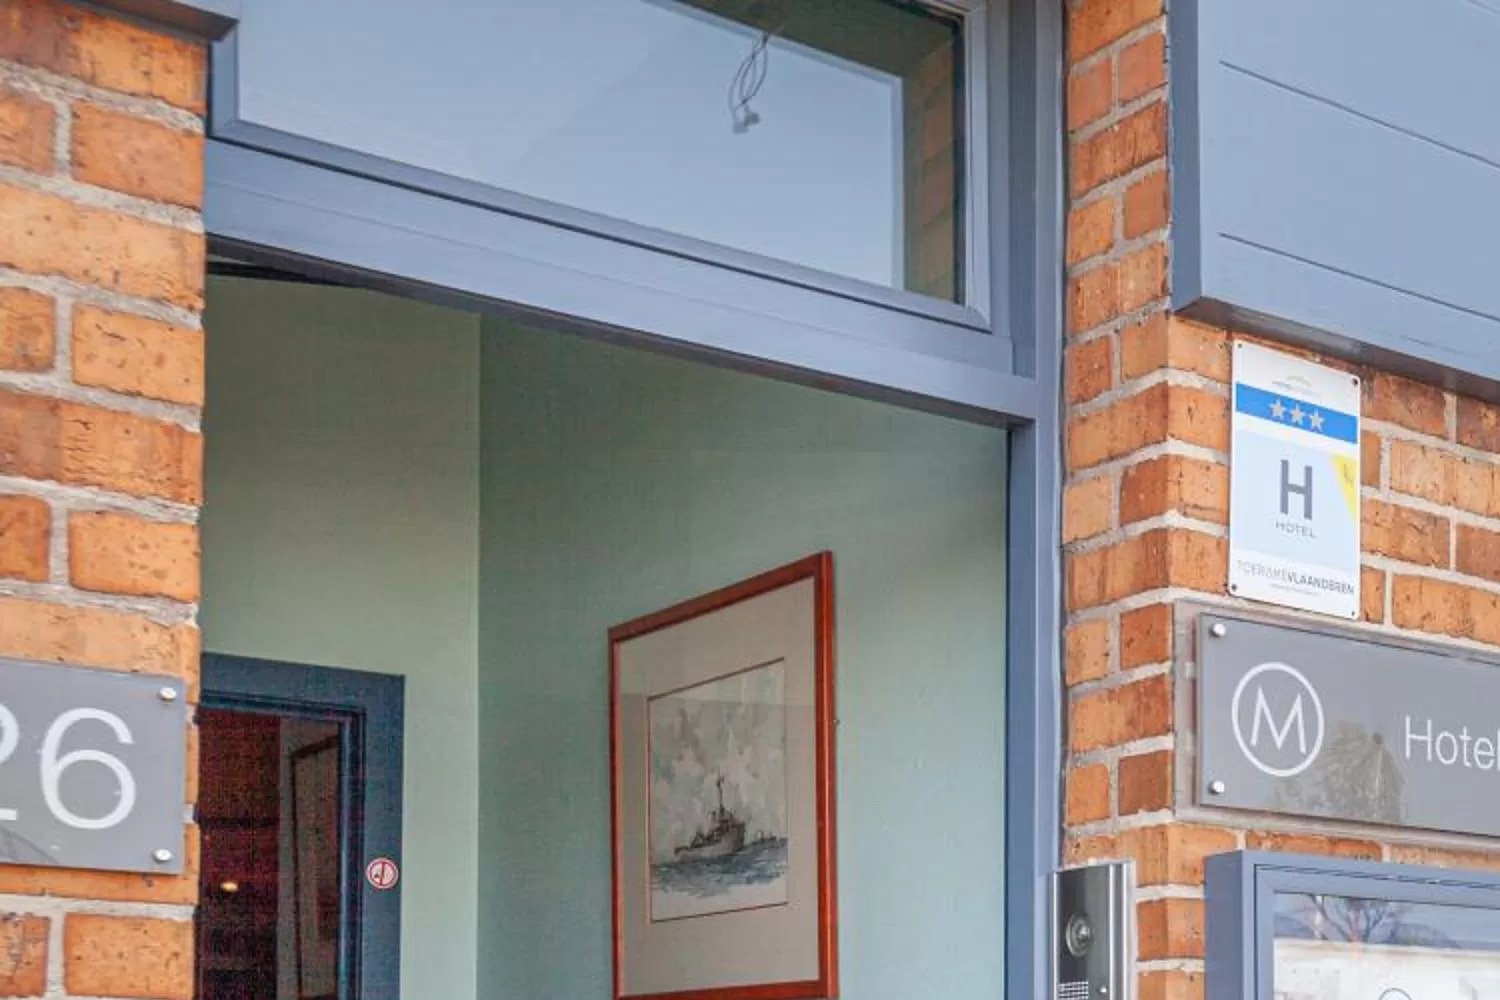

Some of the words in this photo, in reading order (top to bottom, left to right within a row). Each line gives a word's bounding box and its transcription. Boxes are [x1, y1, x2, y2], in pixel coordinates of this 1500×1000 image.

[1280, 459, 1313, 520] H
[1275, 519, 1316, 538] HOTEL
[1250, 685, 1306, 754] M
[0, 702, 136, 829] 6
